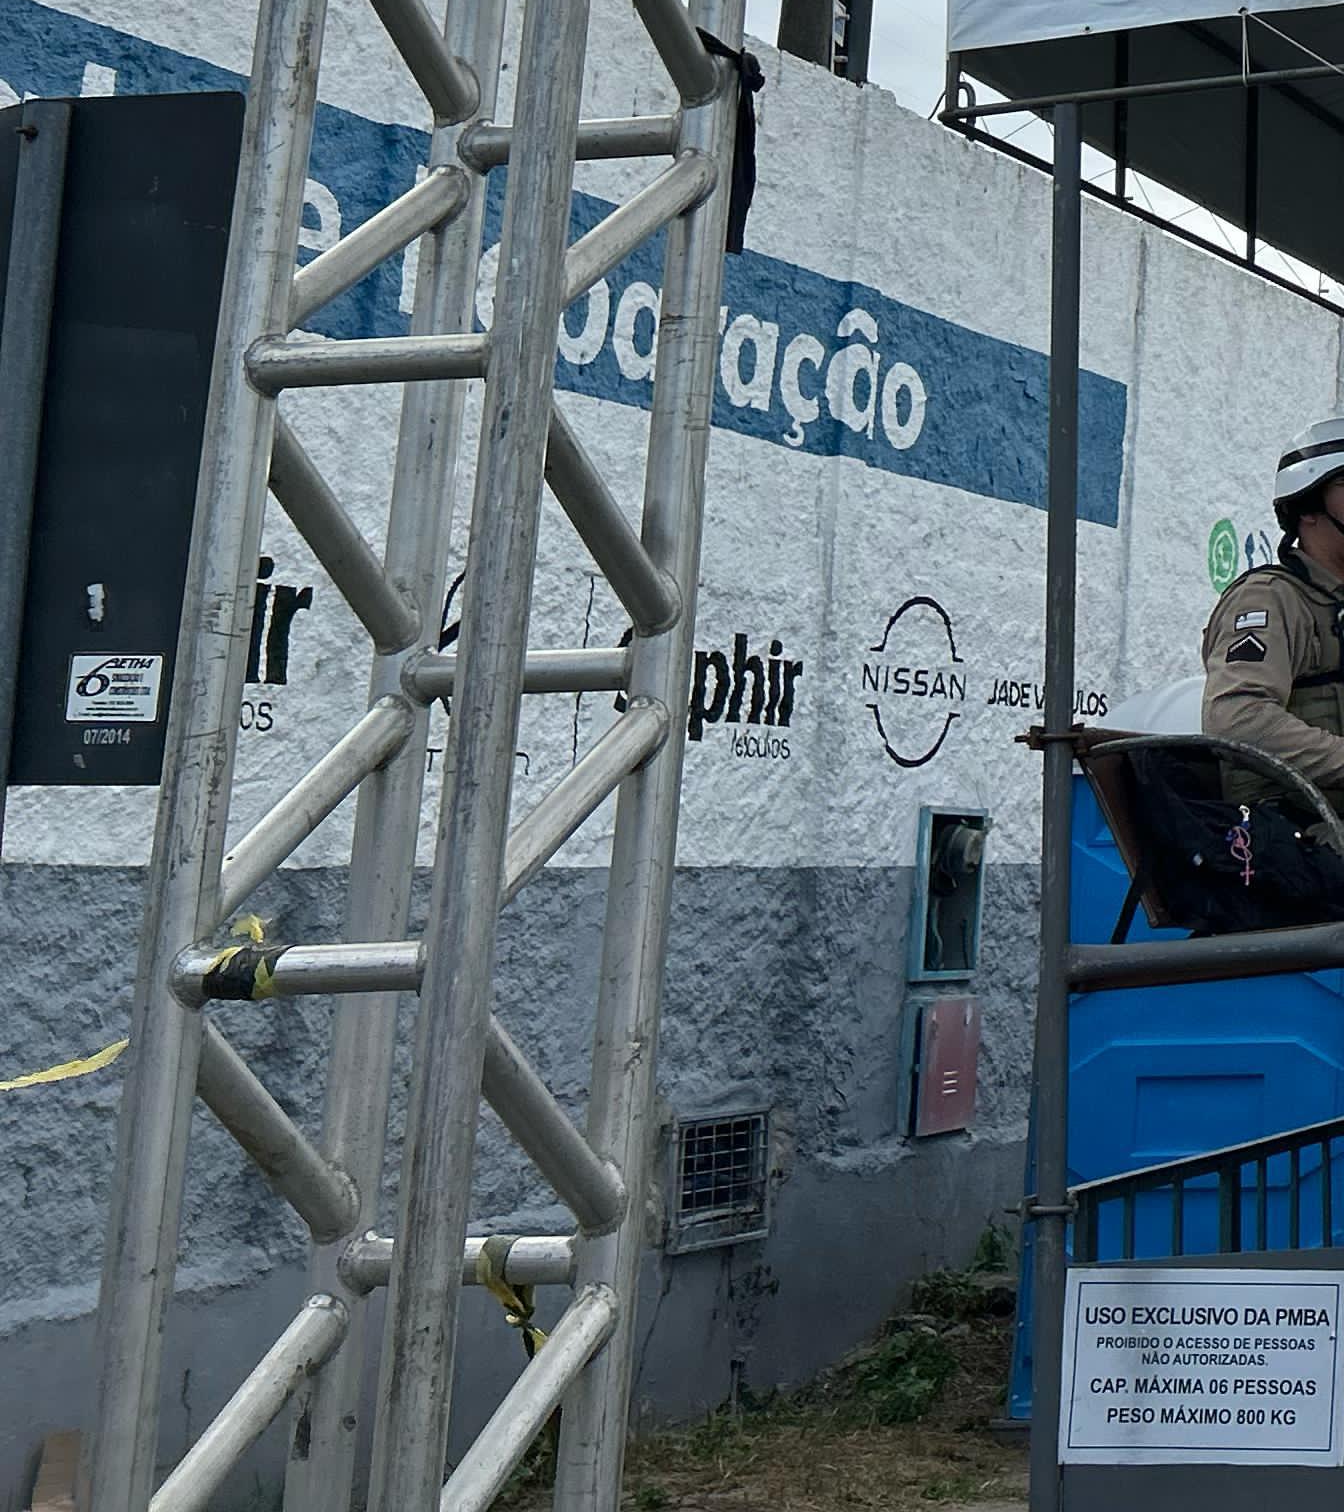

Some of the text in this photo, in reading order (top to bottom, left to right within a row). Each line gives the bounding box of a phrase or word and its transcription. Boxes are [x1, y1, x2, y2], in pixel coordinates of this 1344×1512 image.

[862, 663, 967, 702] NISSAN
[987, 679, 1032, 708] JADE
[83, 728, 131, 744] 07/2014
[1085, 1307, 1330, 1327] USO EXCLUSIVO DA PMBA
[1096, 1337, 1316, 1351] PROIBIDO O ACESSO DE PESSOAS
[1142, 1351, 1269, 1367] NÃO AUTORIZADAS.
[1090, 1374, 1317, 1396] CAP. MÁXIMA 06 PESSOAS
[1107, 1404, 1297, 1426] PESO MÁXIMO 800 KG
